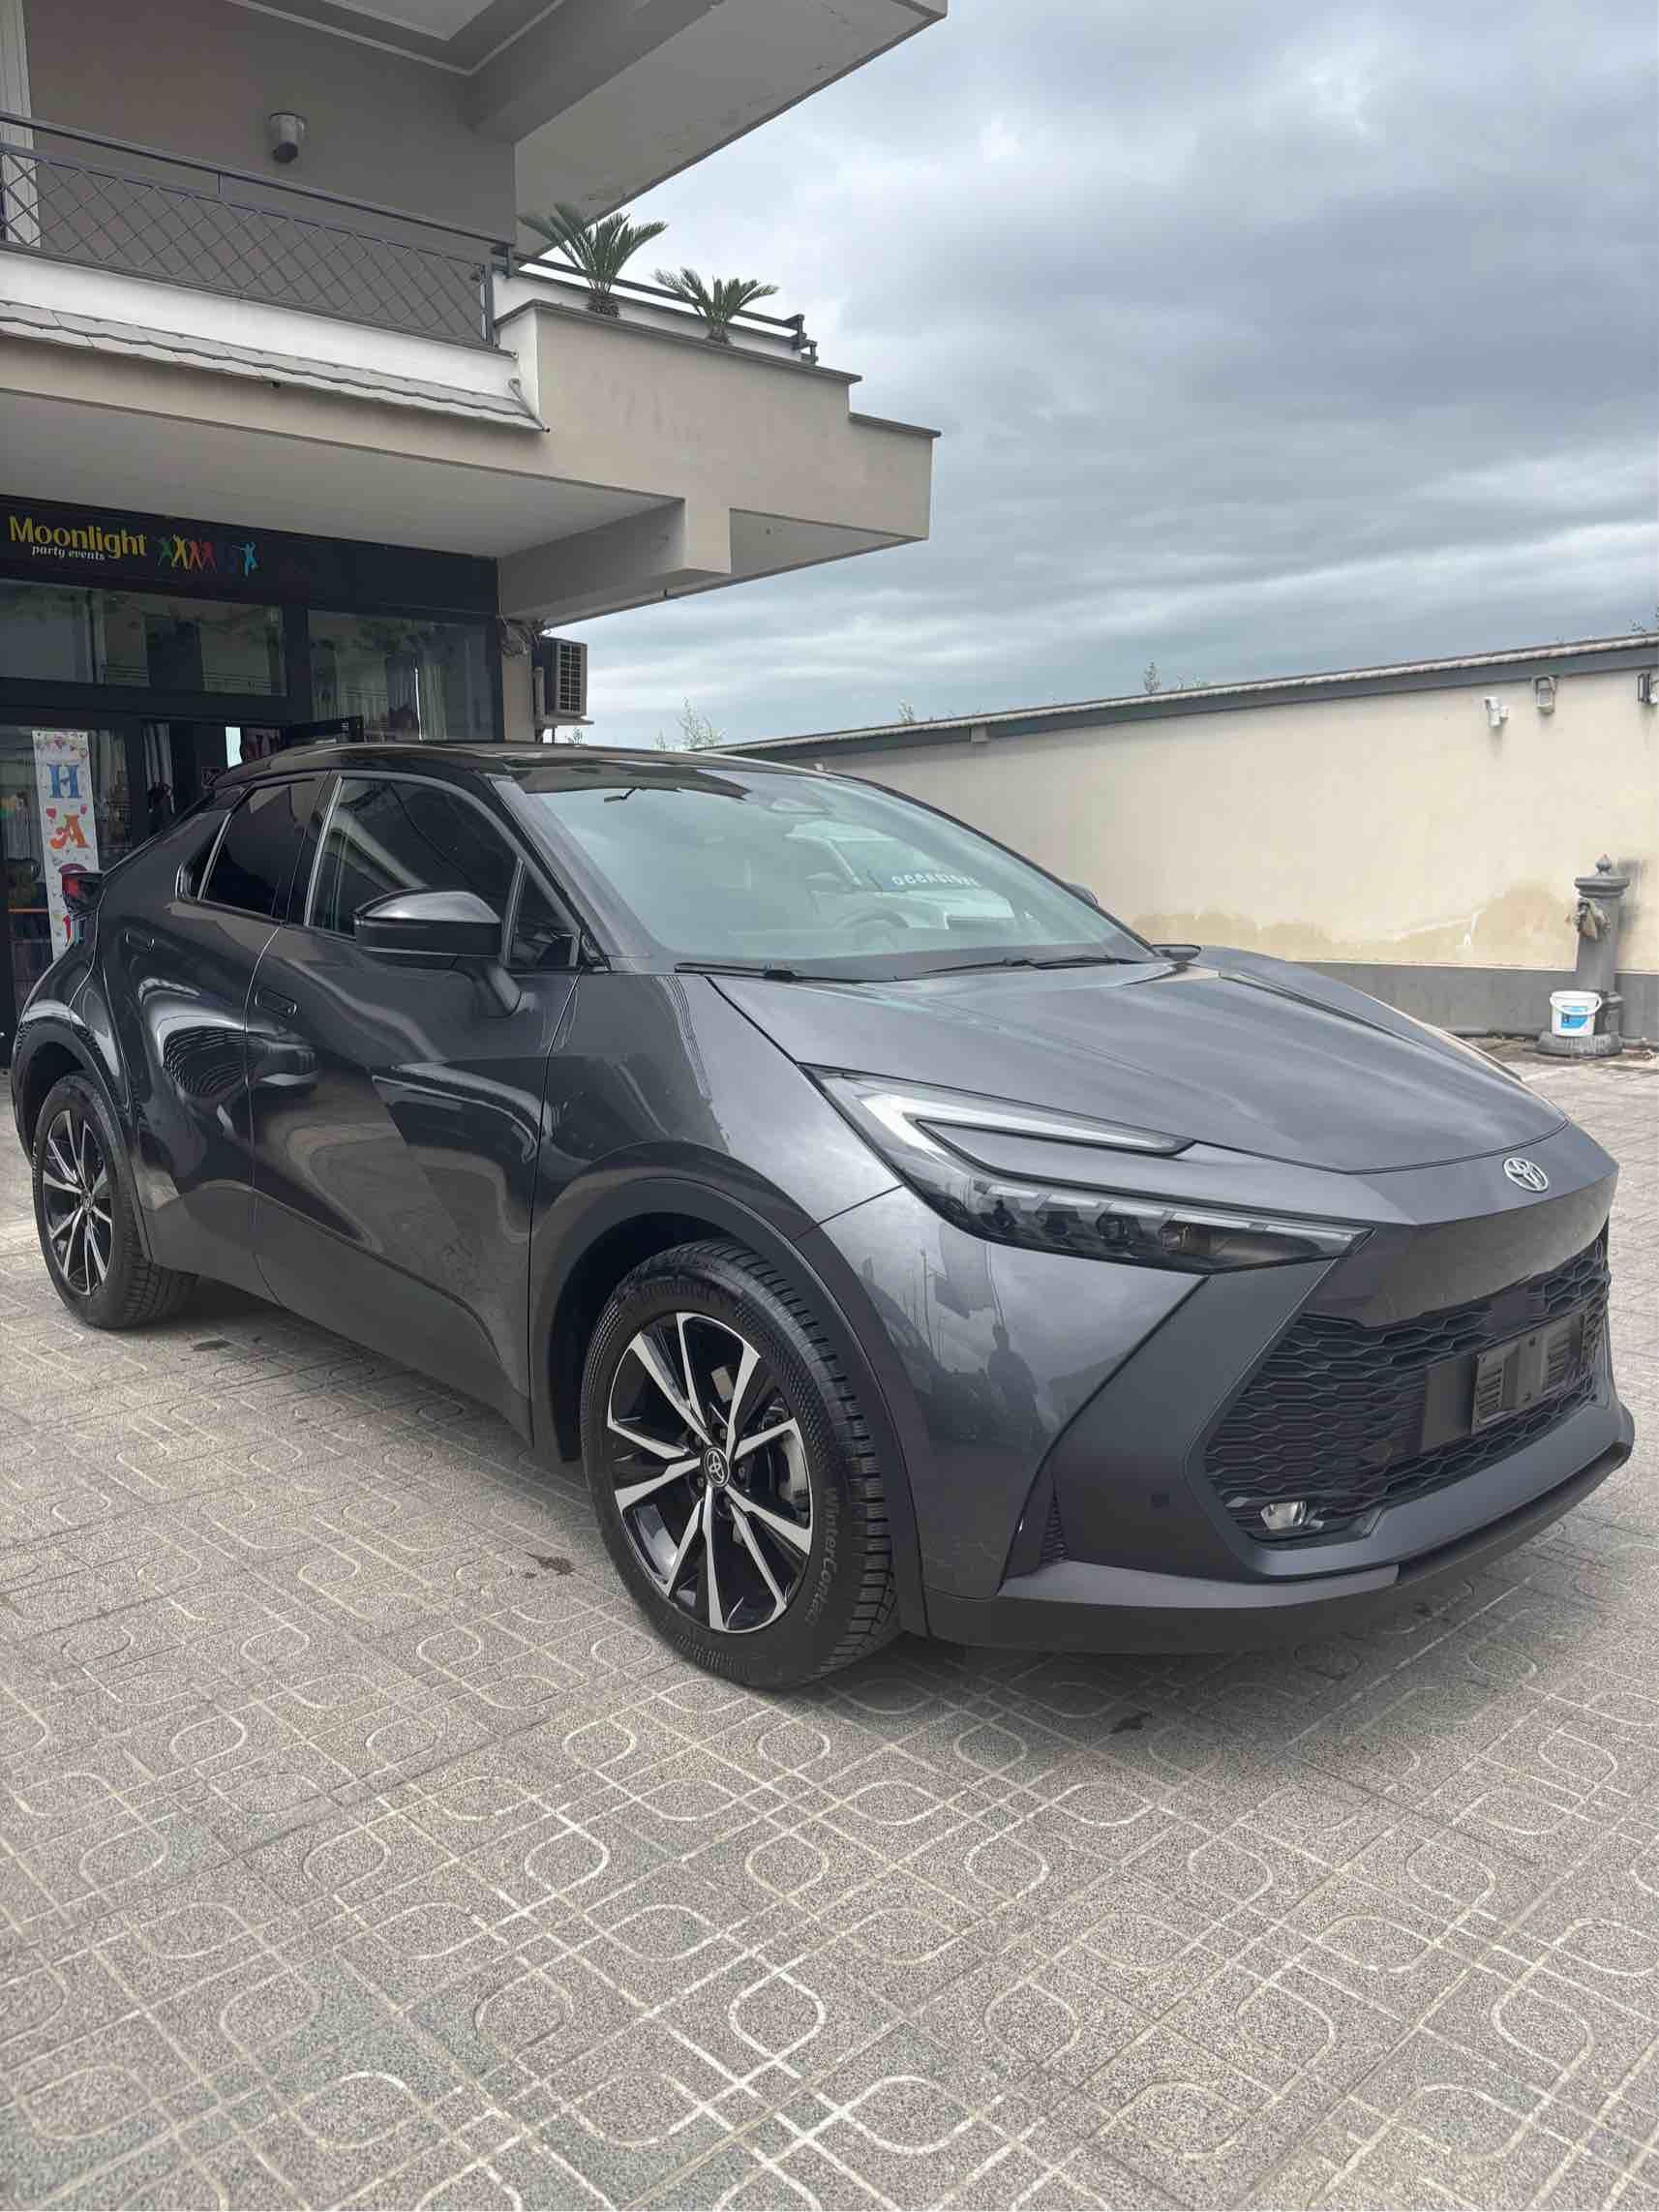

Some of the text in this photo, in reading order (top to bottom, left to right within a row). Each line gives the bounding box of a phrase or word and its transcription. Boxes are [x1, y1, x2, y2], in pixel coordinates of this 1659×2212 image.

[9, 515, 147, 559] Moonlight
[31, 545, 106, 561] party events
